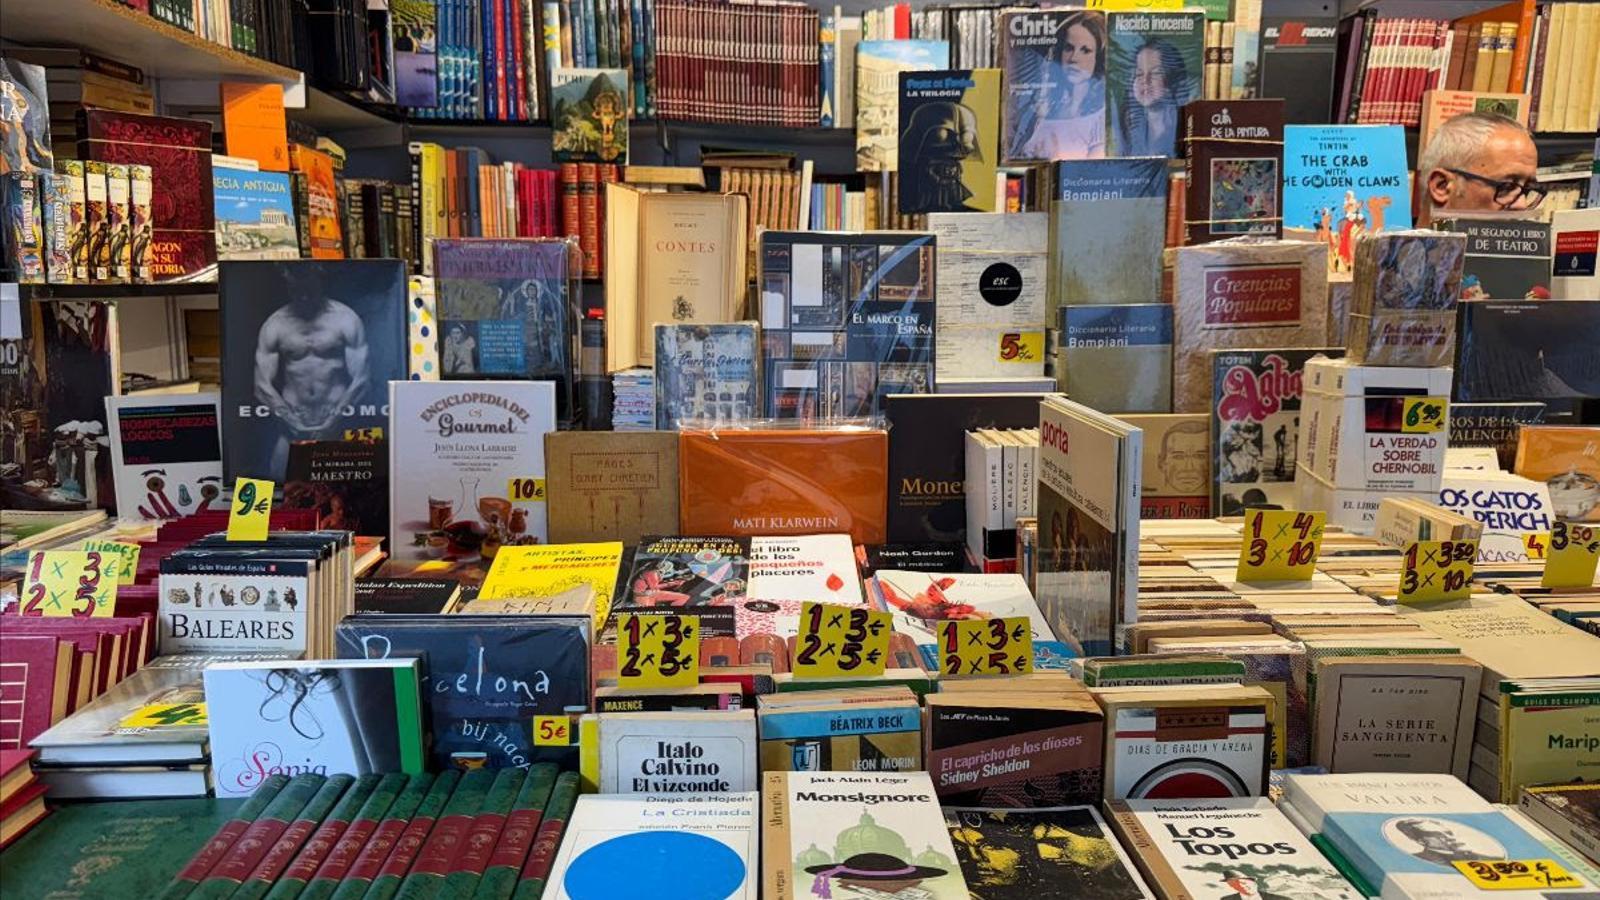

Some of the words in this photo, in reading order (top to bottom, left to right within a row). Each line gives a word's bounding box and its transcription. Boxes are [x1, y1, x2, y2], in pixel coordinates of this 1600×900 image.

[1009, 16, 1057, 37] Chris
[1115, 15, 1149, 31] Nacida
[1151, 15, 1194, 31] inocente
[1300, 26, 1337, 38] REICH
[1026, 36, 1058, 46] destino
[1210, 128, 1222, 138] DE
[1224, 127, 1235, 137] LA
[1236, 126, 1270, 138] PINTURA
[1318, 142, 1349, 150] TINTIN
[1301, 154, 1327, 167] THE
[1333, 154, 1369, 167] CRAB
[1324, 168, 1347, 176] WITH
[1063, 177, 1111, 187] Diccionario
[1283, 176, 1297, 187] HE
[1302, 175, 1353, 188] GOLDEN
[1358, 176, 1400, 188] CLAWS
[1063, 188, 1123, 202] Bompiani
[1467, 226, 1478, 236] MI
[1480, 227, 1520, 239] SEGUNDO
[1522, 228, 1546, 239] LIBRO
[656, 240, 716, 253] CONTES
[1475, 239, 1489, 251] DE
[1495, 240, 1538, 252] TEATRO
[993, 277, 1009, 286] esc
[1213, 275, 1292, 294] Creencias
[1210, 293, 1293, 321] Populares
[867, 315, 902, 325] MARCO
[905, 315, 919, 325] EN
[898, 323, 933, 335] ESPAÑA
[1068, 325, 1117, 335] Diccionario
[1118, 324, 1156, 333] Literario
[1068, 335, 1129, 349] Bompiani
[1219, 356, 1253, 365] TOTEM
[420, 392, 508, 422] ENCICLOPEDIA
[508, 402, 530, 424] DEL
[438, 412, 518, 437] Gourmet
[1042, 420, 1069, 455] porta
[1370, 437, 1385, 448] LA
[1390, 437, 1437, 449] VERDAD
[1383, 450, 1421, 461] SOBRE
[596, 459, 633, 468] PAGES
[1372, 462, 1437, 474] CHERNOBIL
[311, 470, 372, 481] MAESTRO
[901, 478, 965, 495] Mone
[237, 481, 268, 516] 9€
[1439, 488, 1470, 507] OS
[1472, 490, 1543, 510] GATOS
[733, 516, 766, 528] MATI
[769, 516, 839, 528] KLARWEIN
[1362, 513, 1375, 521] EN
[1473, 511, 1550, 531] PERICH
[1252, 511, 1264, 538] 1
[768, 545, 801, 553] libro
[1247, 538, 1268, 567] 3
[30, 551, 45, 583] 1
[749, 560, 824, 569] pequeños
[751, 569, 816, 578] placeres
[1402, 570, 1419, 595] 3
[22, 583, 46, 617] 2
[169, 613, 294, 640] BALEARES
[809, 603, 823, 635] 1
[844, 608, 885, 643] 3€
[623, 615, 640, 647] 1
[662, 615, 693, 648] 3€
[943, 621, 958, 654] 1
[986, 618, 1025, 651] 3€
[798, 634, 821, 665] 2
[837, 643, 882, 671] 5€
[621, 648, 642, 677] 2
[659, 648, 693, 677] 5€
[604, 700, 643, 712] MAXENCE
[540, 720, 568, 740] 5€
[830, 715, 874, 731] BÉATRIX
[878, 715, 903, 728] BECK
[1358, 718, 1377, 729] LA
[1385, 719, 1436, 730] SERIE
[462, 720, 490, 742] bij
[1341, 731, 1449, 743] SANGRIENTA
[657, 741, 704, 758] Italo
[1155, 744, 1168, 755] DE
[1172, 743, 1208, 754] GRACIA
[1212, 743, 1217, 752] Y
[1221, 742, 1253, 752] ARENA
[1548, 733, 1600, 752] Marip
[941, 757, 953, 772] El
[954, 747, 1007, 769] capricho
[1006, 744, 1021, 758] de
[1023, 741, 1040, 755] los
[1042, 734, 1083, 750] dioses
[641, 759, 720, 776] Calvino
[881, 757, 916, 770] MORIN
[940, 769, 983, 787] Sidney
[982, 759, 1030, 778] Sheldon
[632, 778, 649, 792] El
[652, 778, 730, 793] vizconde
[810, 776, 835, 784] Jack
[875, 776, 909, 785] Léger
[646, 796, 683, 804] Diego
[708, 796, 753, 804] Hojeda
[796, 791, 930, 805] Monsignore
[1164, 823, 1236, 839] Los
[1172, 839, 1297, 860] Topos
